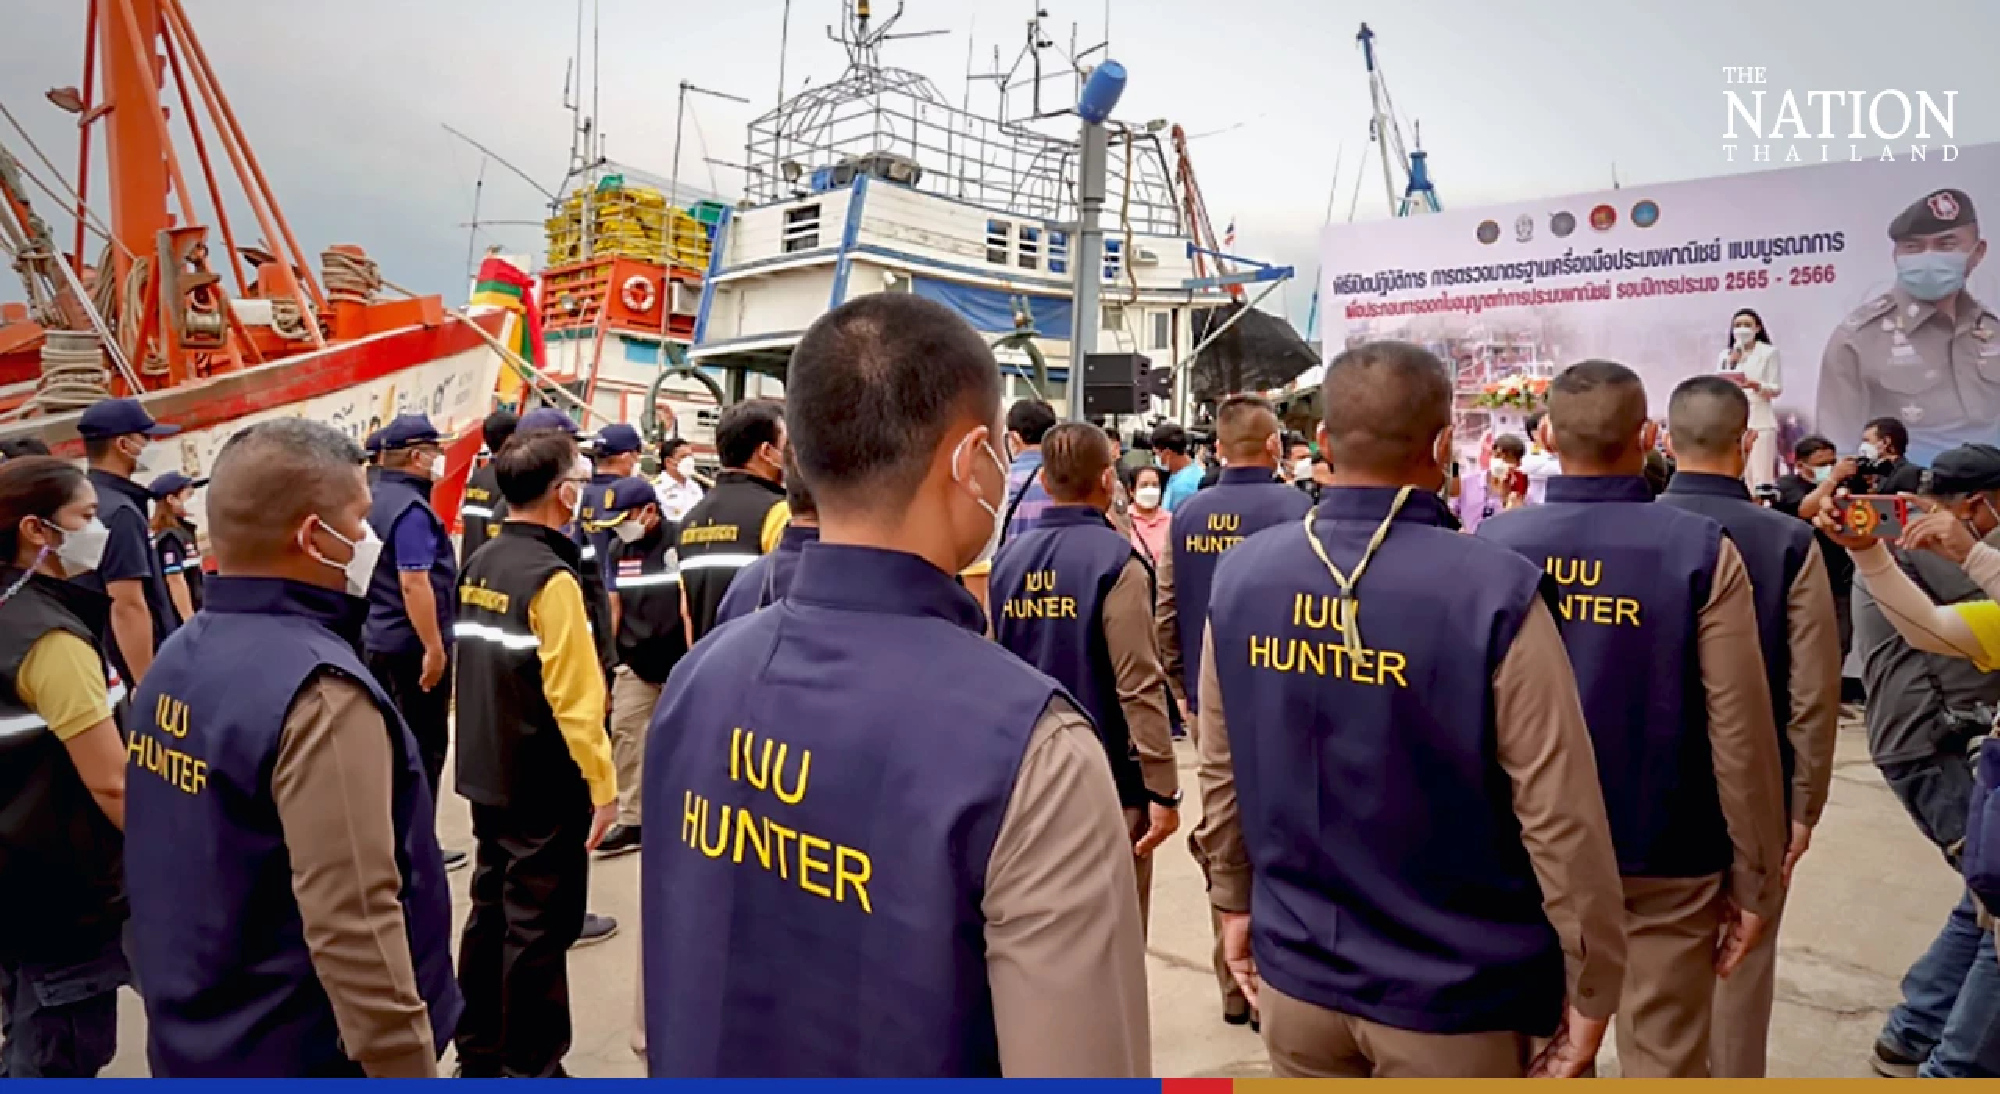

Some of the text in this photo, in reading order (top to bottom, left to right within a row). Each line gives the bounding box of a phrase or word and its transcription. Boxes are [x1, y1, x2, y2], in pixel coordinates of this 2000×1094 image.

[1333, 231, 1846, 297] พิธีเปิดปฏิบัติการ การตรวจมาตรฐานเครื่องมือประมงพาณิชย์ แบบบูรณาการ
[1616, 275, 1720, 299] รอบปีการประมง
[1725, 269, 1770, 291] 2565
[1789, 264, 1837, 287] 2566
[1207, 513, 1241, 531] IUU
[1185, 533, 1245, 553] HUNT
[1545, 555, 1603, 586] IUU
[1558, 594, 1641, 627] NTER
[1249, 634, 1409, 688] HUNTER
[156, 692, 189, 738] IUU
[730, 727, 811, 804] IUU
[682, 789, 873, 914] HUNTER
